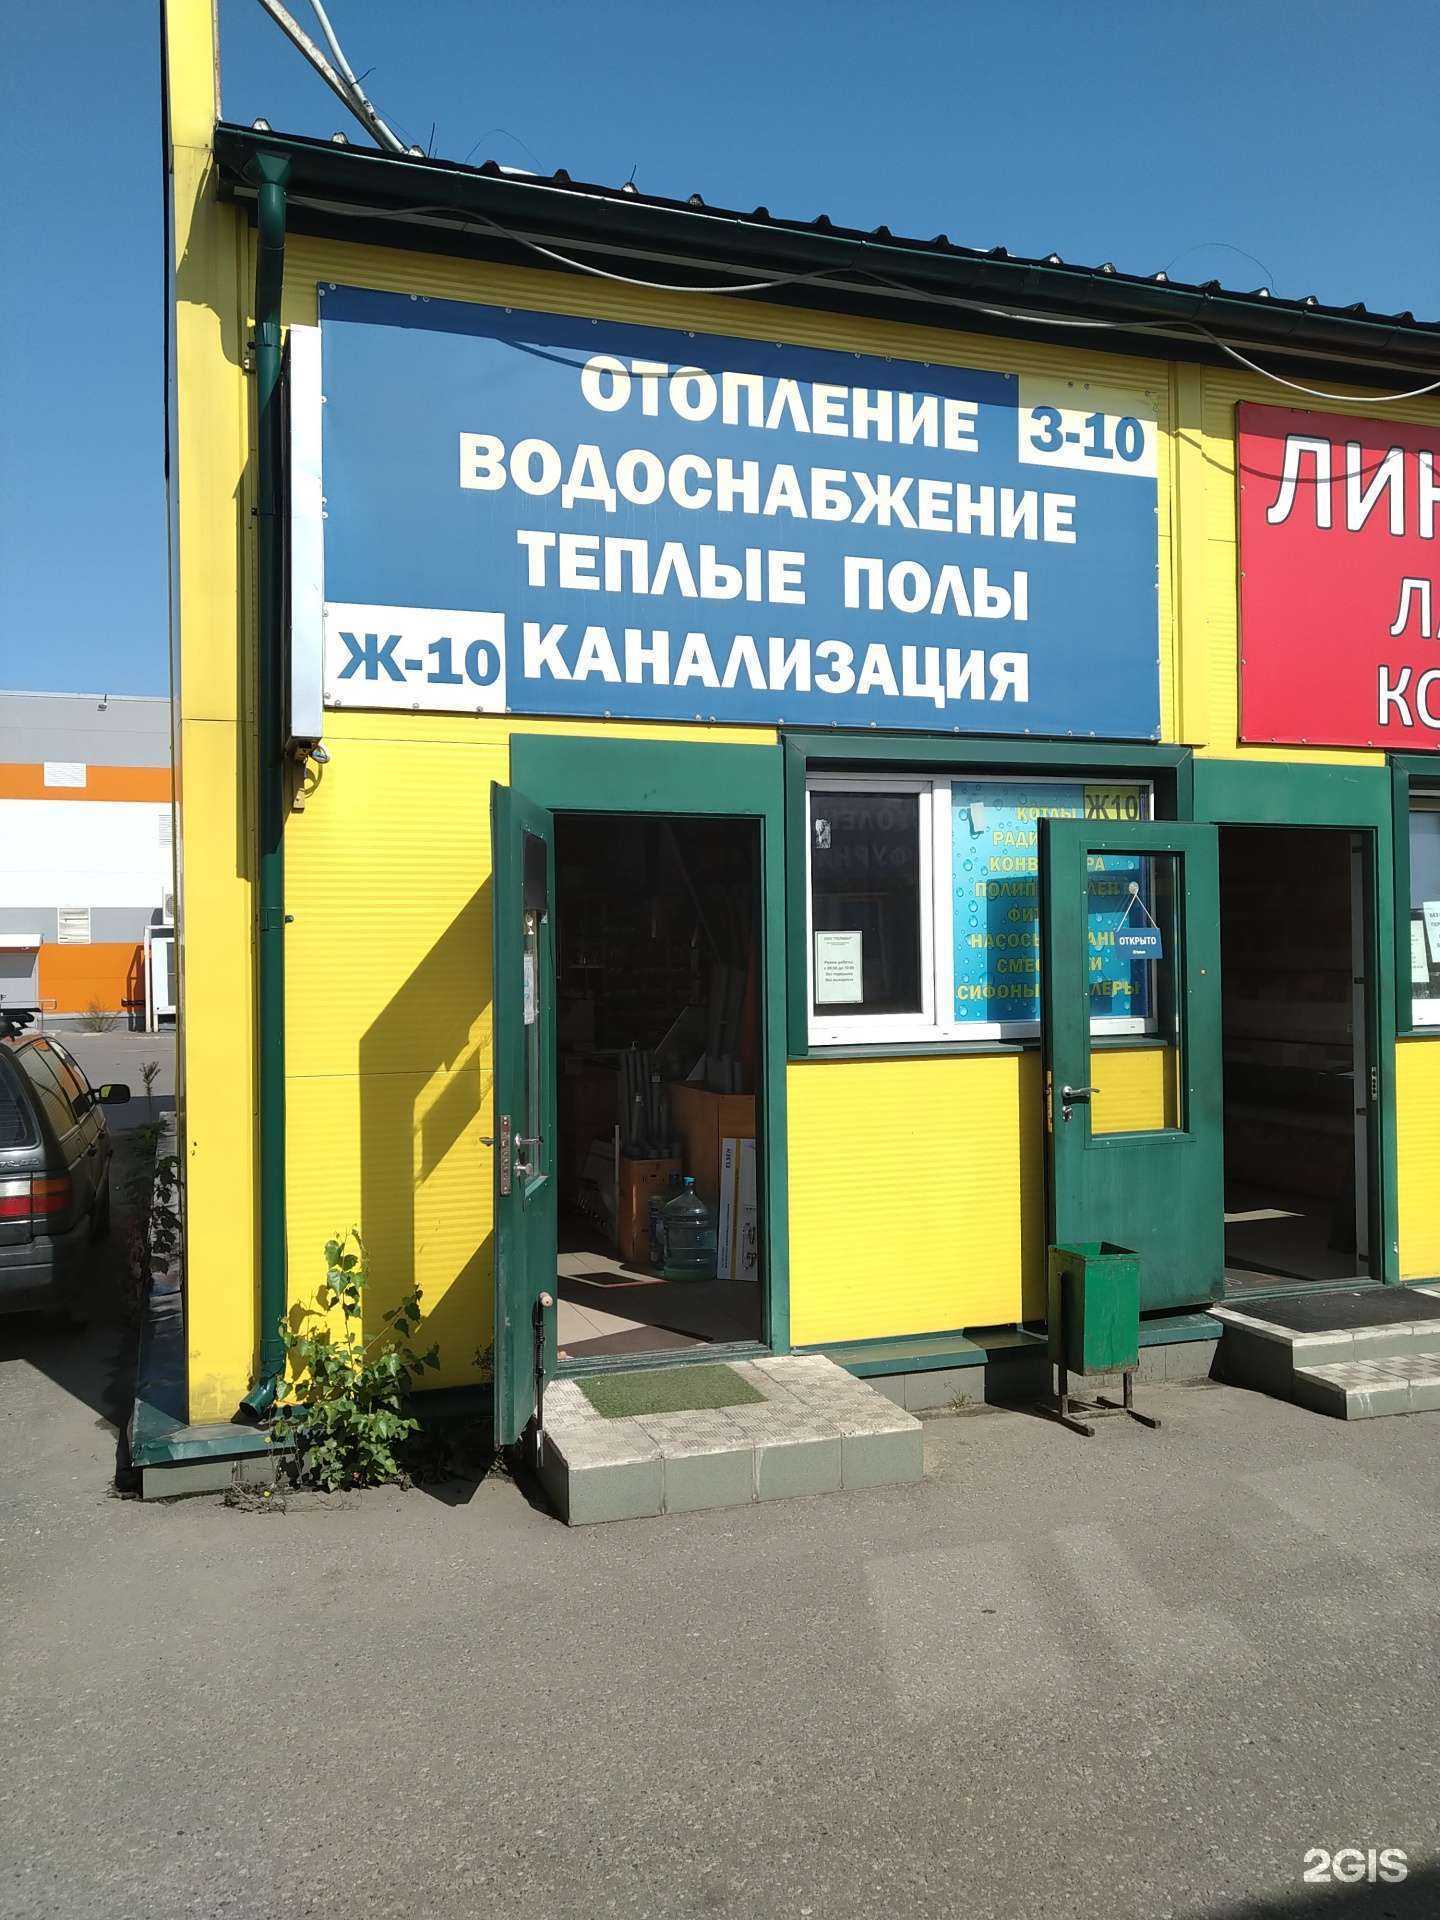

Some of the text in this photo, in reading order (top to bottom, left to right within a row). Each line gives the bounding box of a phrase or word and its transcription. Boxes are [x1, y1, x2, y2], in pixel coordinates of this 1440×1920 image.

[581, 355, 979, 453] ОТОПЛЕНИЕ
[459, 432, 1077, 544] ВОДОСНАБЖЕНИЕ
[517, 529, 1029, 621] ТЕПЛЫЕ ПОЛЫ
[337, 631, 501, 686] Ж-10
[522, 622, 1029, 709] КАНАЛИЗАЦИЯ
[1016, 806, 1076, 820] КОТЛЫ
[1119, 936, 1157, 945] ОТКРЫТО
